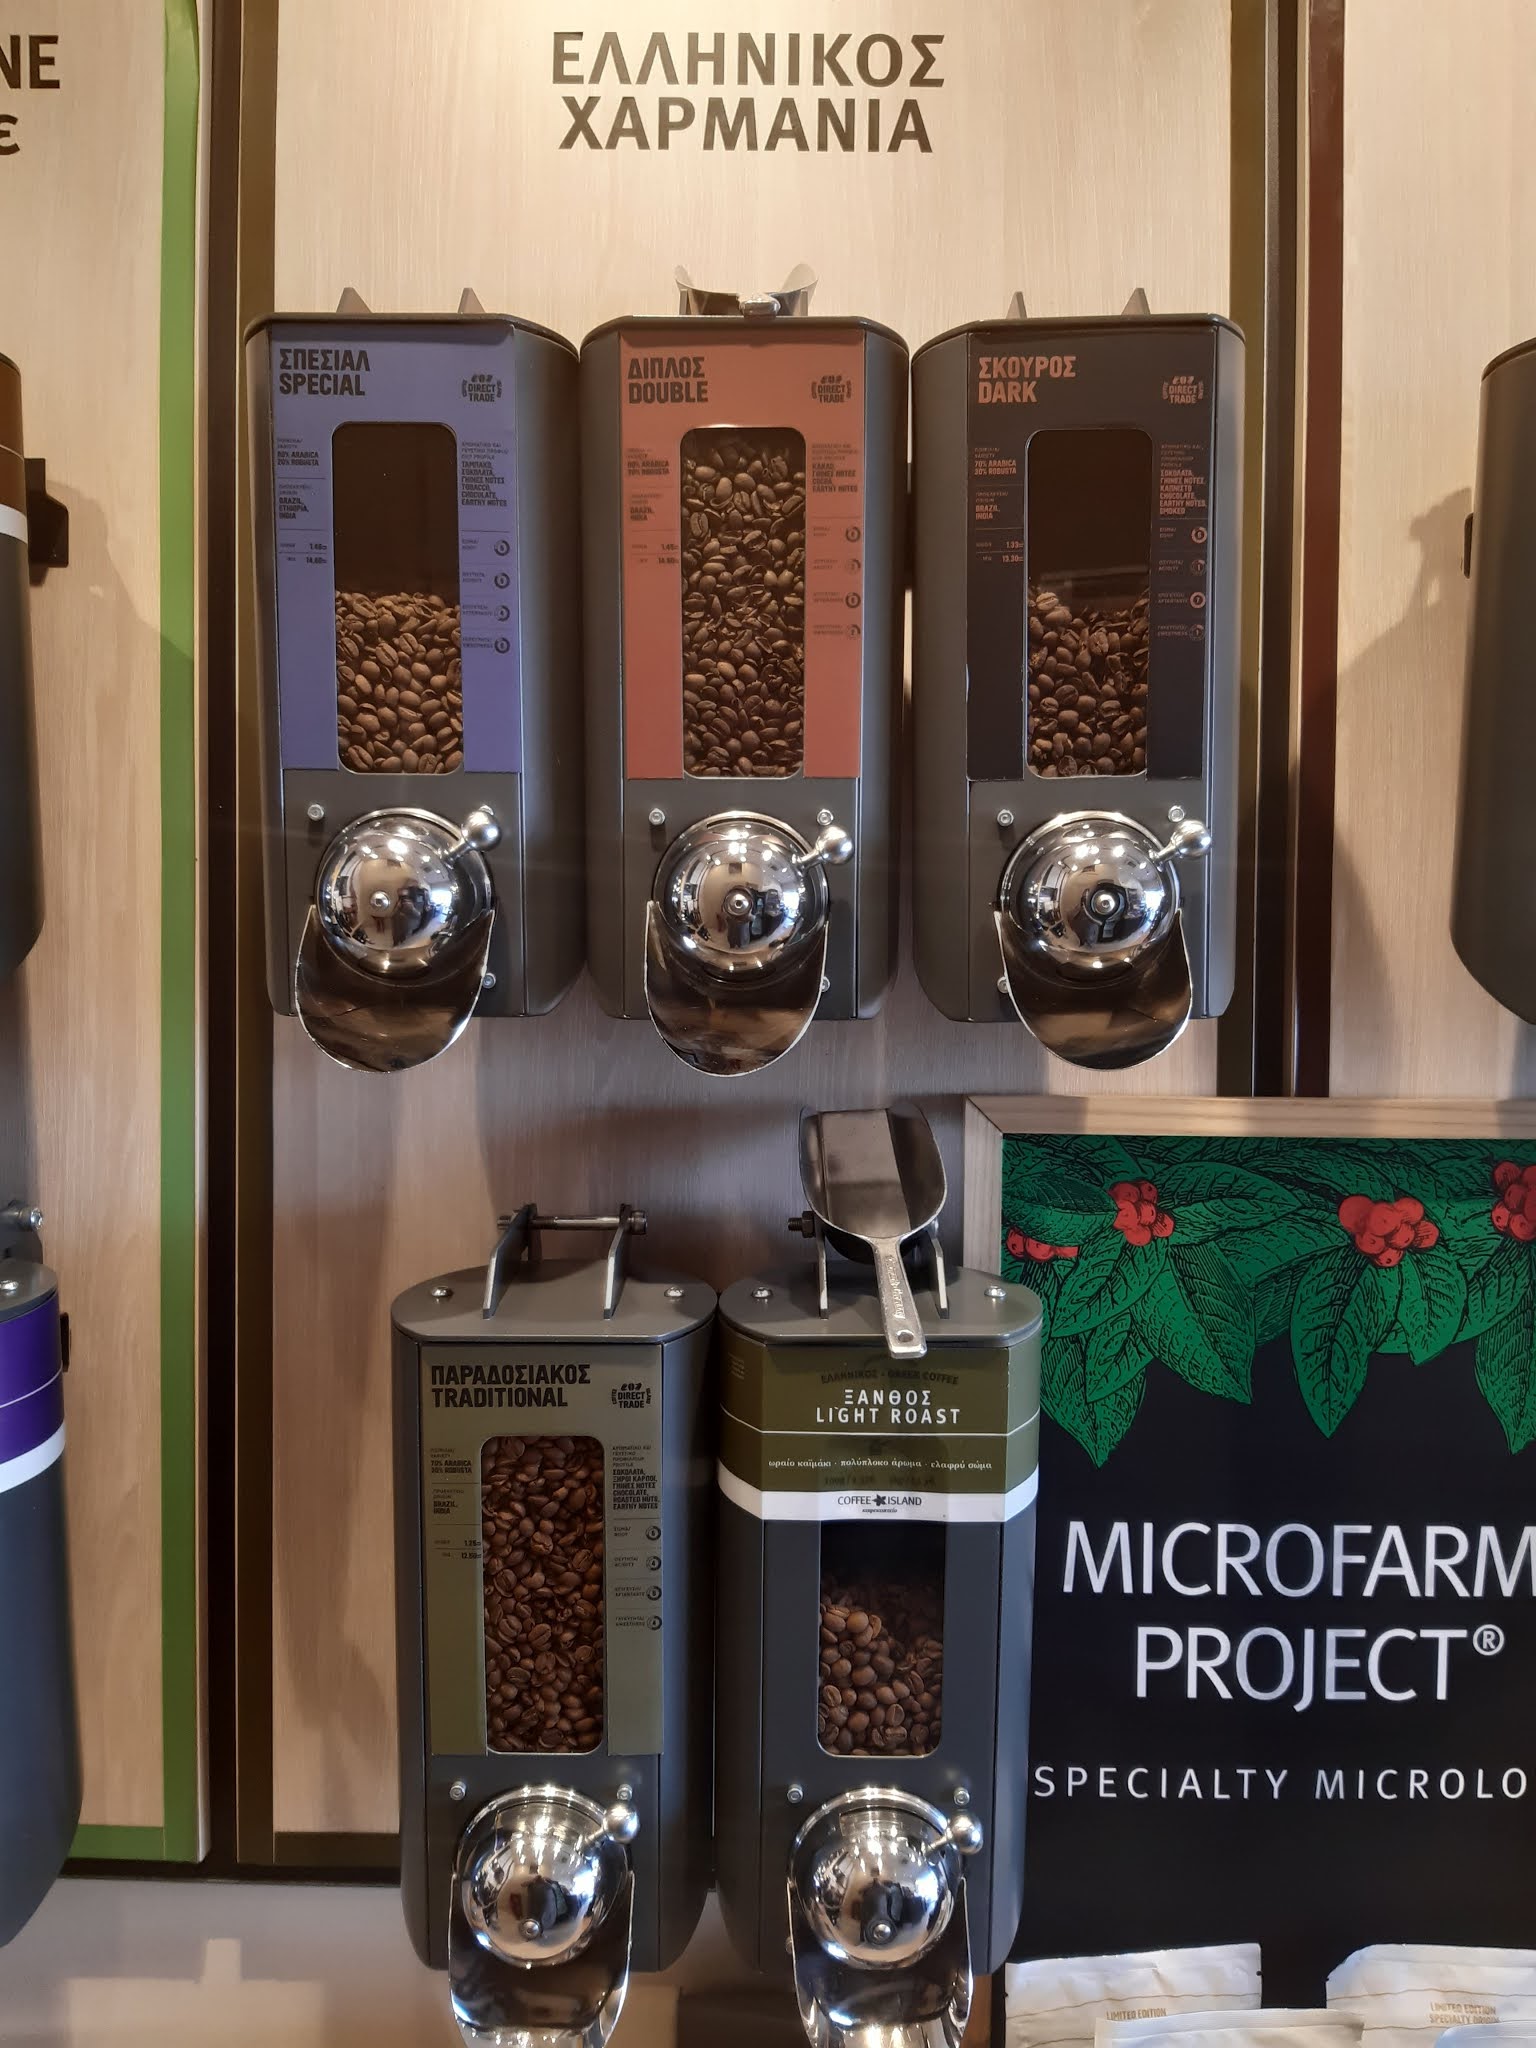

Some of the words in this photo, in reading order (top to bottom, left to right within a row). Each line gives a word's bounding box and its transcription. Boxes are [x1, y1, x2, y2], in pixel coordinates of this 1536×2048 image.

[552, 31, 945, 88] ΕΛΛΗΝΙΚΟΣ
[558, 96, 933, 153] ΧΑΡΜΑΝΙΑ
[279, 348, 371, 372] ΣΠΕΣΙΑΛ
[627, 357, 705, 379] ΔΙΠΛΟΣ
[978, 355, 1077, 379] ΣΚΟΥΡΟΣ
[279, 372, 366, 397] SPECIAL
[467, 384, 496, 392] DIRECT
[628, 380, 709, 404] DOUBLE
[817, 385, 845, 393] DIRECT
[977, 380, 1038, 404] DARK
[1168, 386, 1197, 394] DIRECT
[468, 393, 496, 402] TRADE
[818, 394, 845, 403] TRADE
[1169, 395, 1196, 404] TRADE
[431, 1363, 592, 1385] ΠΑΡΑΔΟΣΙΑΚΟΣ
[922, 1371, 960, 1385] COFFEE
[431, 1386, 569, 1408] TRADITIONAL
[617, 1391, 645, 1400] DIRECT
[618, 1400, 645, 1409] TRADE
[844, 1388, 931, 1406] ΞΑΝΘΟΣ
[816, 1407, 879, 1423] LIGHT
[891, 1407, 961, 1425] ROAST
[768, 1458, 795, 1469] ωραίο
[837, 1495, 871, 1506] COFFEE
[887, 1495, 923, 1507] ISLAND
[1062, 1519, 1536, 1598] MICROFARM
[1034, 1765, 1288, 1799] SPECIALTY
[1315, 1767, 1527, 1799] MICROLO
[1106, 2010, 1137, 2021] LIMITED
[1138, 2008, 1167, 2019] EDITION
